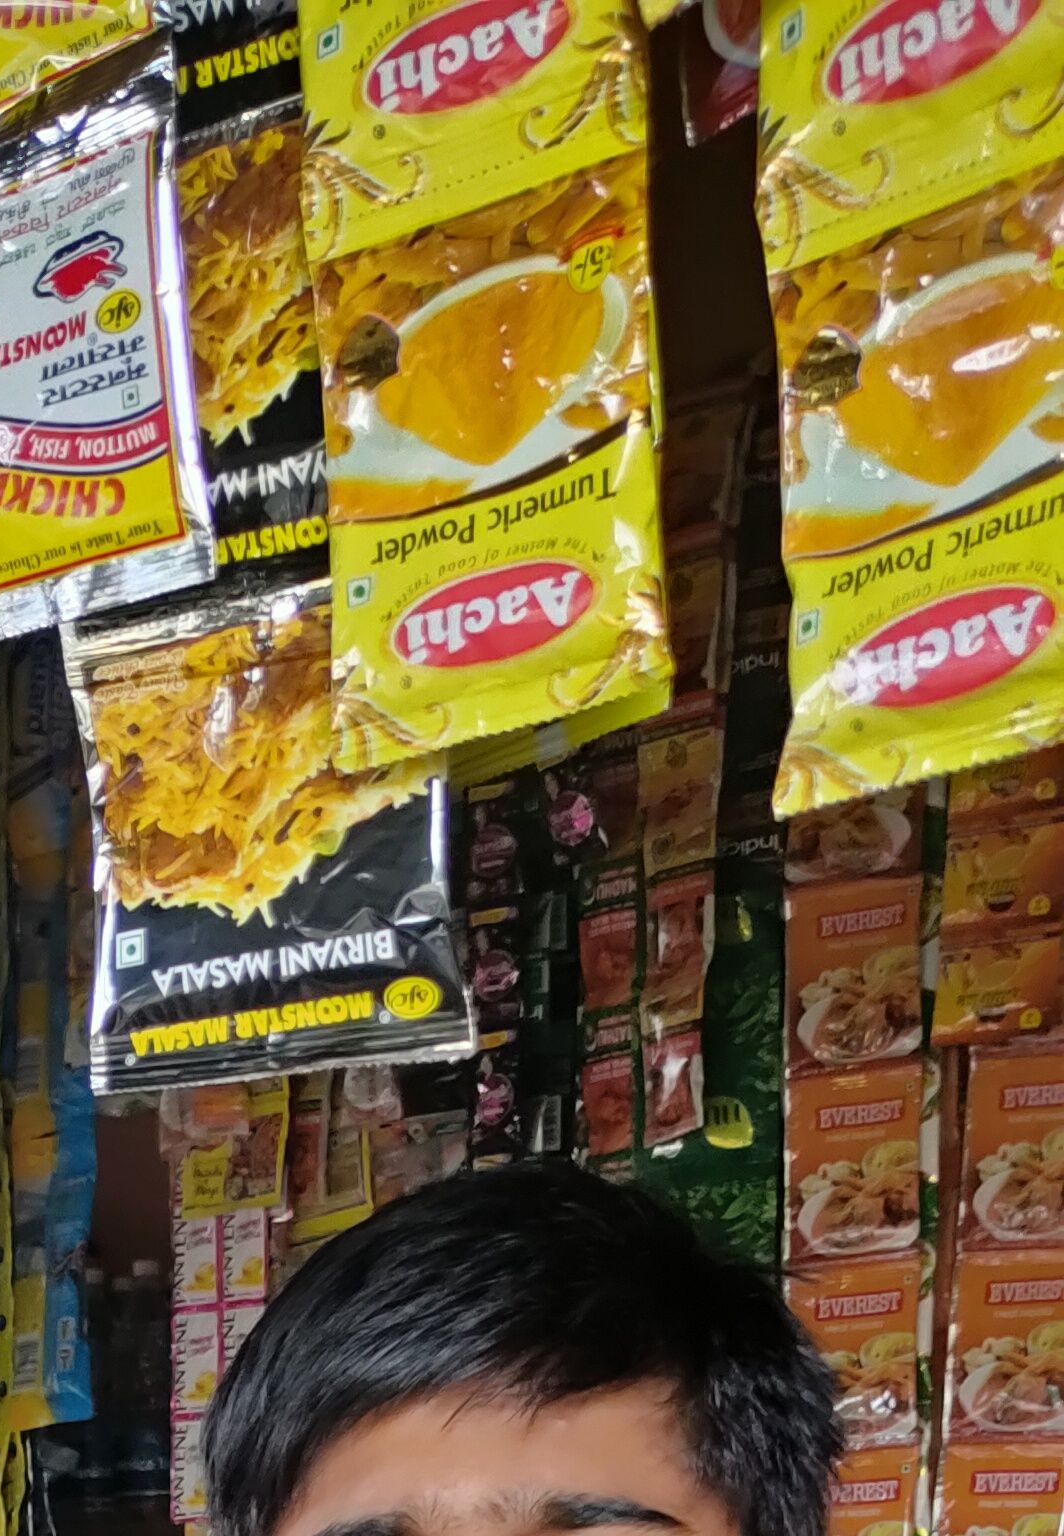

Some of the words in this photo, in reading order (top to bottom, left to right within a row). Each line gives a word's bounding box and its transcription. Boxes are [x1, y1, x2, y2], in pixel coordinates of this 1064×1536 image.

[374, 0, 558, 113] Aachi
[838, 0, 1031, 106] Aachi
[39, 334, 146, 382] मसाला
[27, 434, 70, 460] FISH,
[74, 421, 158, 460] MUTTON,
[487, 468, 618, 534] Turmeric
[945, 491, 1064, 558] urmeric
[44, 546, 67, 560] our
[69, 540, 83, 556] is
[85, 529, 126, 550] Taste
[127, 519, 163, 540] Your
[370, 514, 476, 566] Powder
[821, 539, 935, 599] Powder
[403, 571, 581, 665] Aachi
[855, 596, 1044, 704] Aach
[821, 904, 905, 937] EVEREST
[150, 948, 271, 998] MASALA
[279, 928, 395, 978] BIRYANI
[129, 1015, 229, 1058] MASALA
[234, 992, 373, 1040] MOONSTAR
[819, 1099, 903, 1129] EVEREST
[1003, 1081, 1064, 1109] EVERE
[173, 1213, 187, 1303] PANTEN
[222, 1214, 236, 1302] PANTEN
[817, 1290, 902, 1319] EVEREST
[173, 1319, 188, 1412] PANTENE
[173, 1425, 188, 1519] PANTENE
[974, 1471, 1060, 1495] EVEREST
